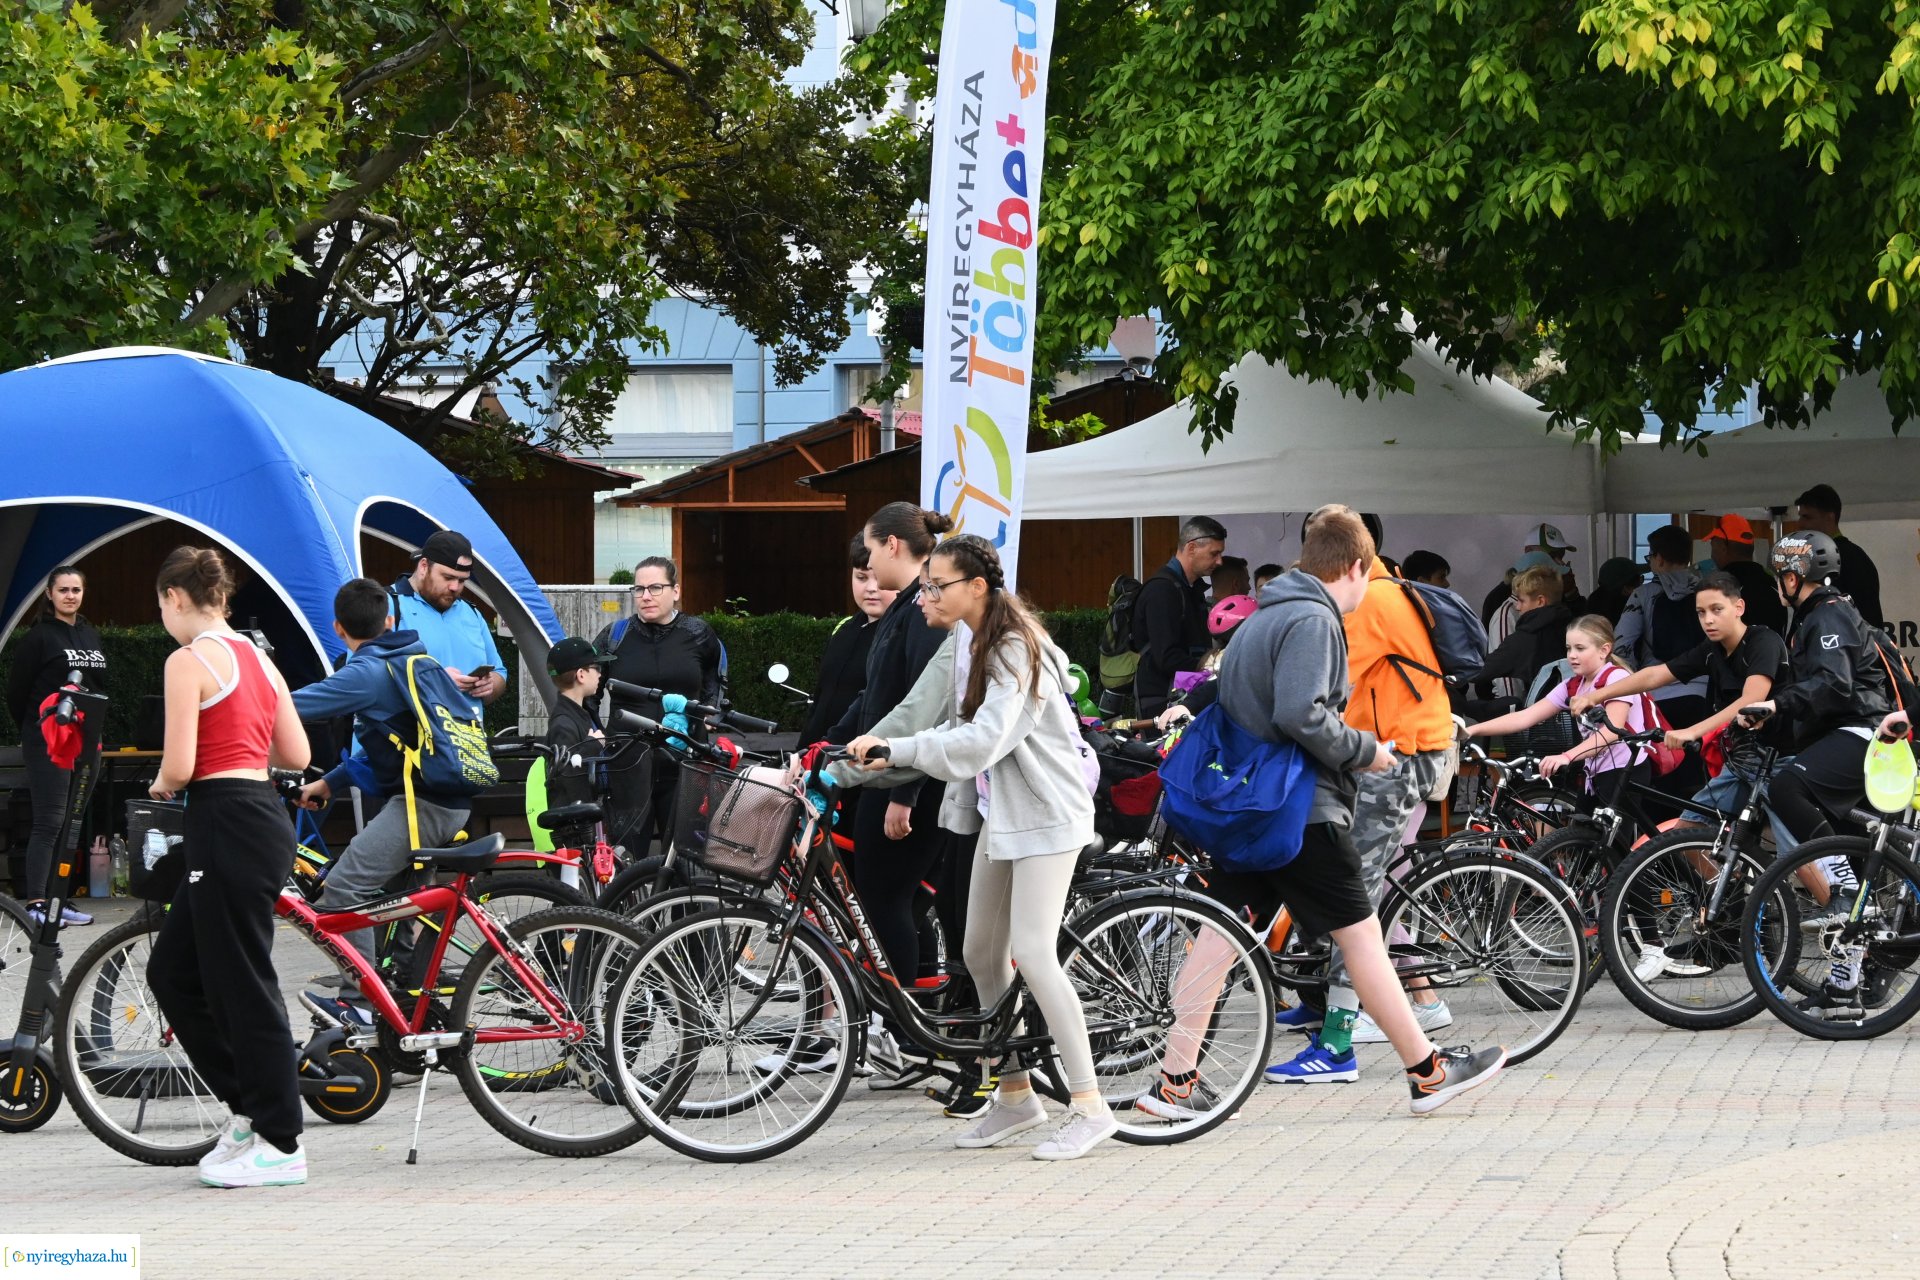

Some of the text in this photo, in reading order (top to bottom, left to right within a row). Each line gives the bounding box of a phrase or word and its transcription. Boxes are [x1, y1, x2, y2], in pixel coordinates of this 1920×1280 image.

[947, 70, 985, 383] NYÍREGYHÁZA
[967, 113, 1033, 388] Többet
[63, 649, 105, 661] BOSS
[286, 908, 367, 983] HAUSER
[846, 892, 888, 970] VENSSINI
